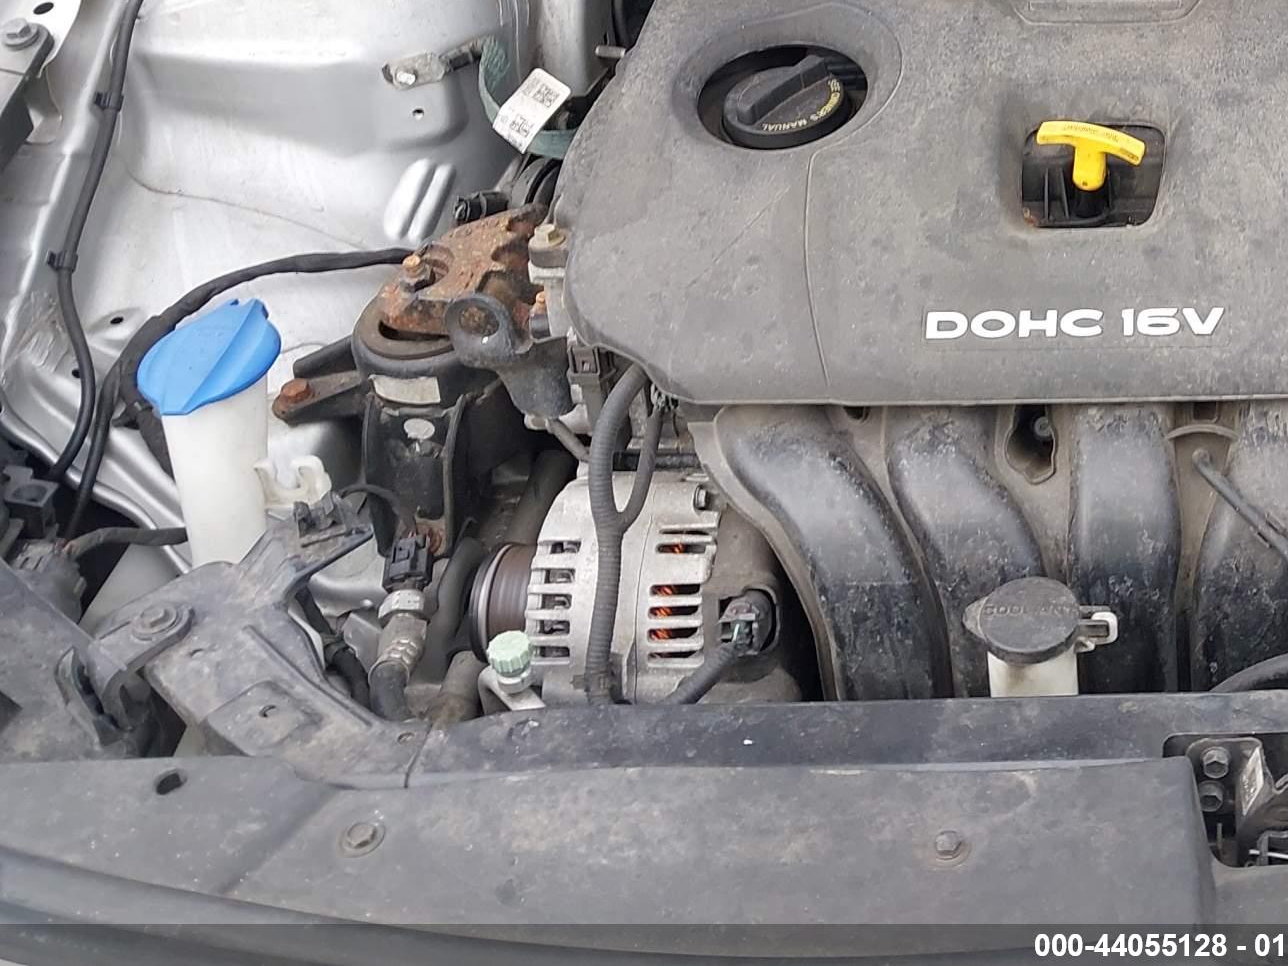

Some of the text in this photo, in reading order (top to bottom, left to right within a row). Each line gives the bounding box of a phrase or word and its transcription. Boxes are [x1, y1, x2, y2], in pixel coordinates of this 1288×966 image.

[762, 118, 808, 132] MANUAL
[926, 307, 1225, 339] DOHC 16V
